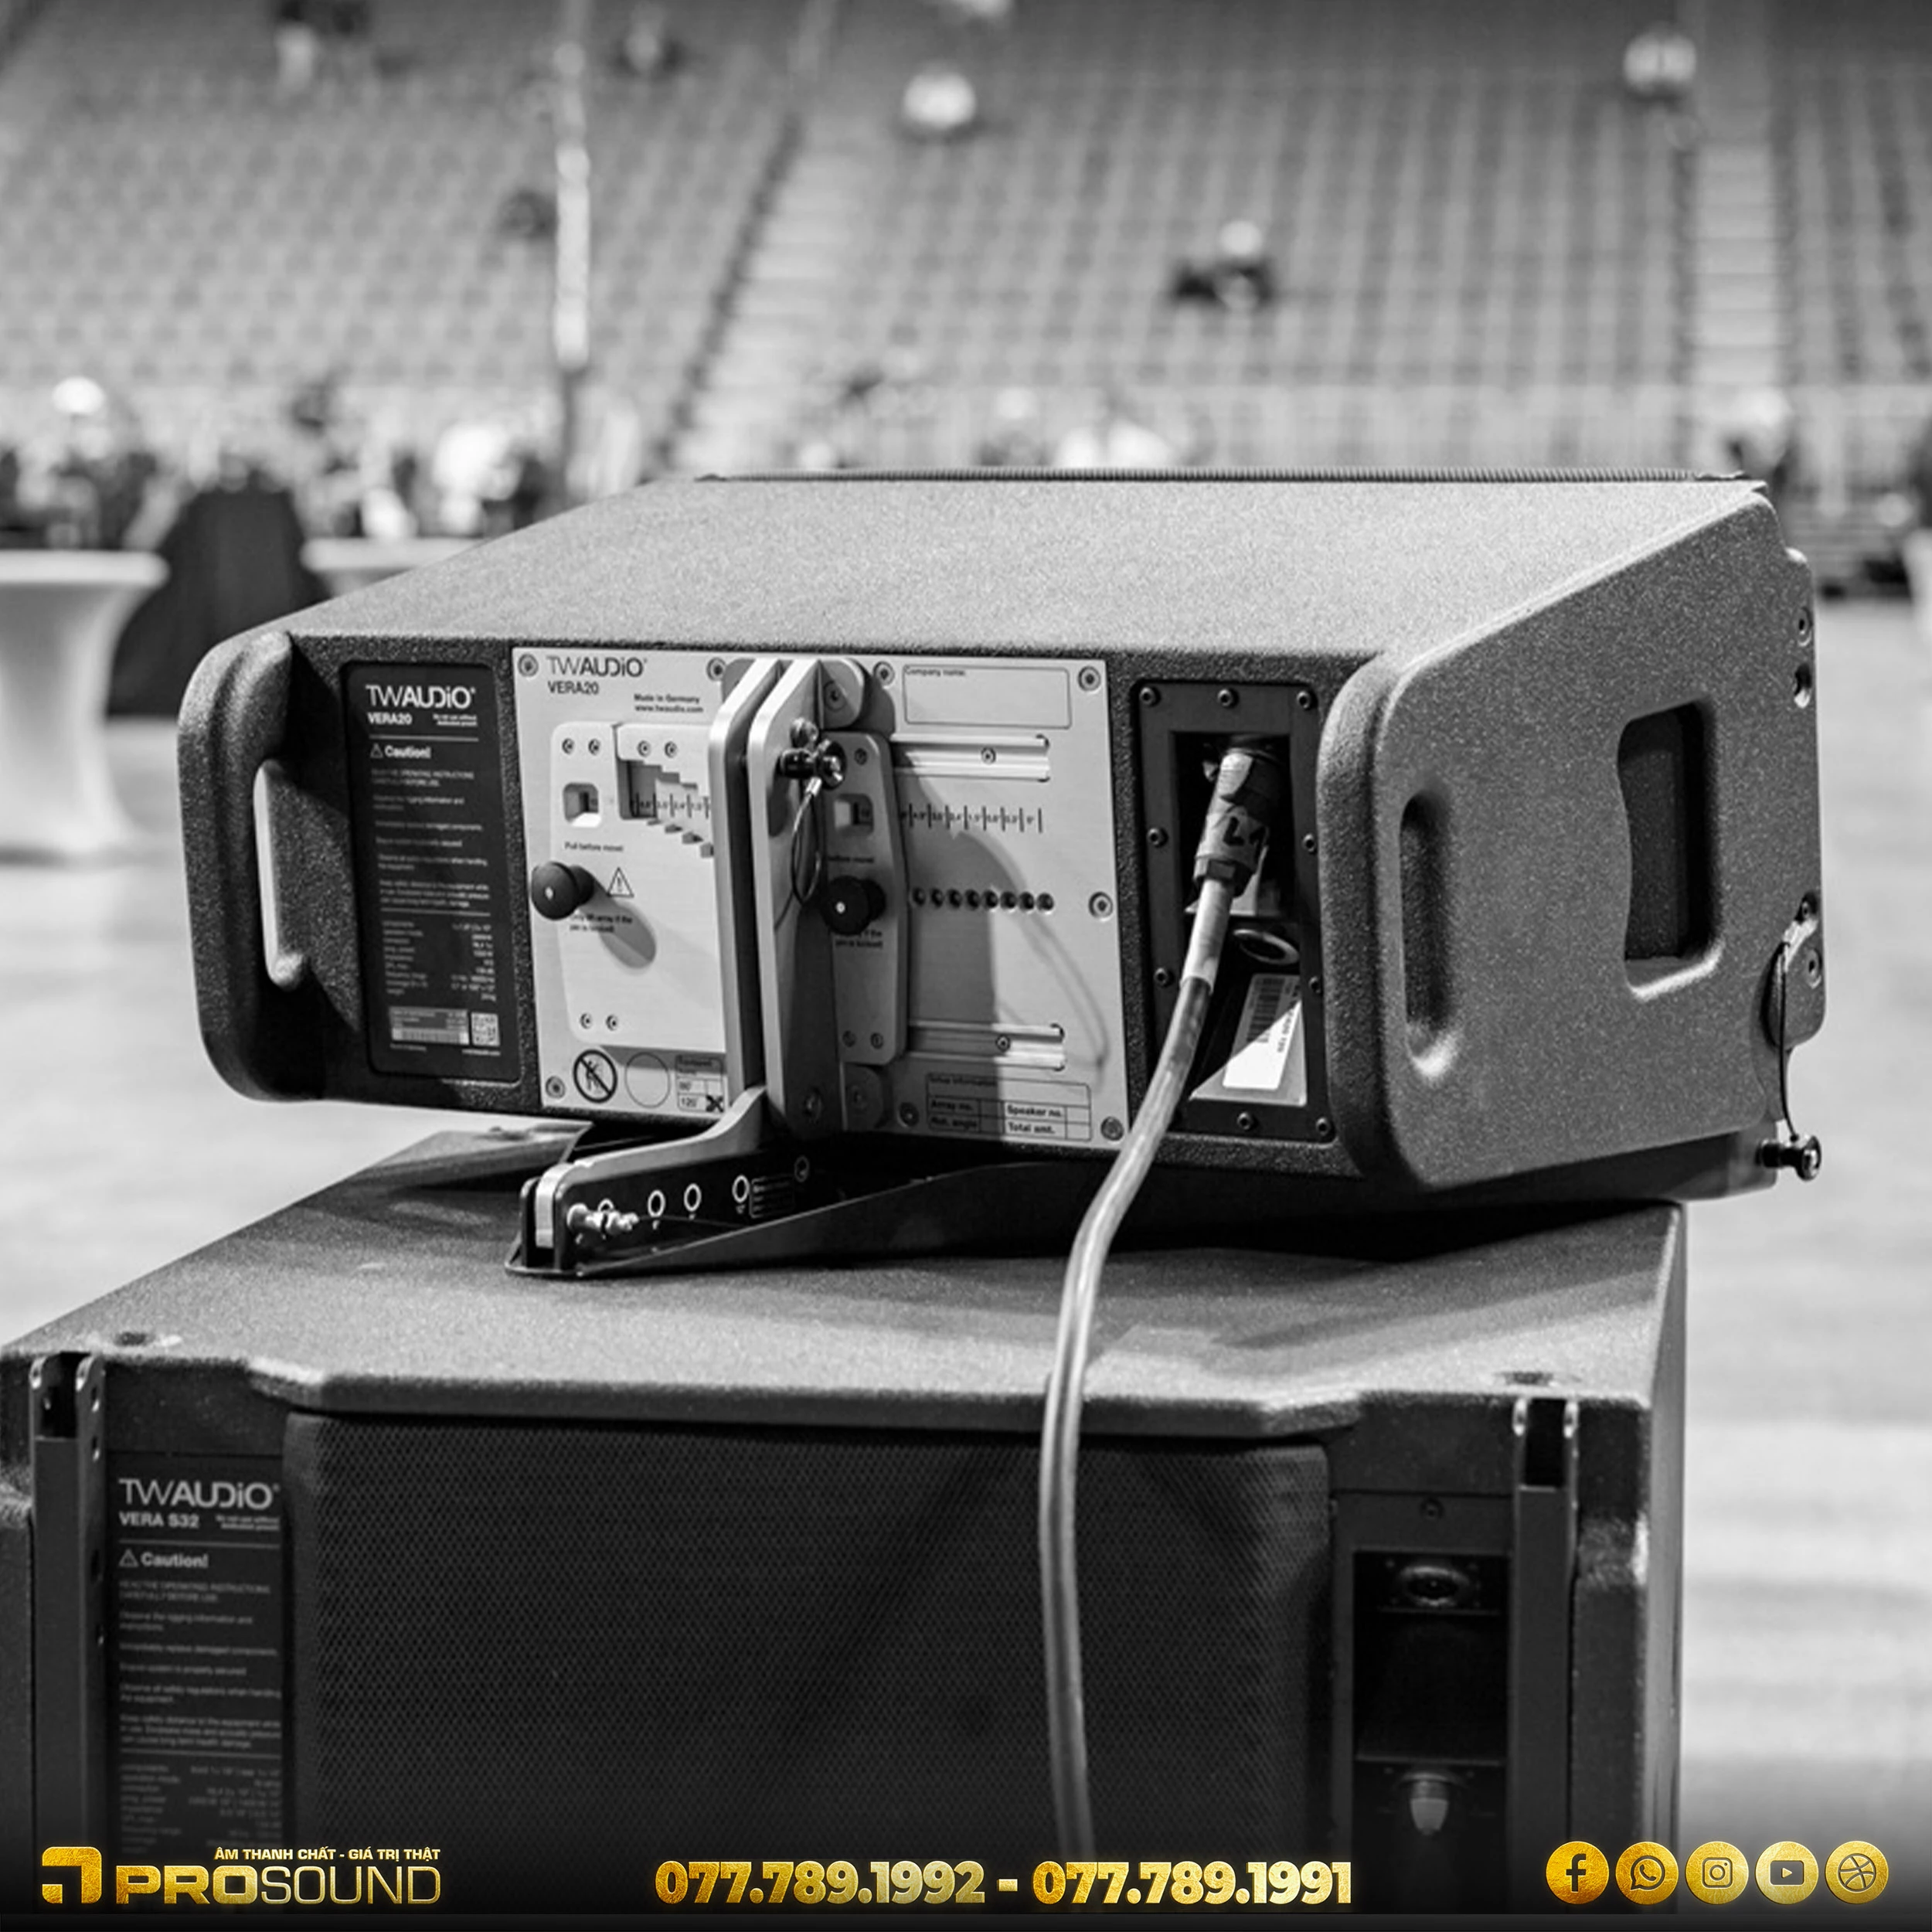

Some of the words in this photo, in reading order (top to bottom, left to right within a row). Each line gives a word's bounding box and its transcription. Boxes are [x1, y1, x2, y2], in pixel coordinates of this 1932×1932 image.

[548, 681, 600, 695] VERA20
[665, 693, 700, 704] Germany
[367, 712, 413, 725] VERA20
[385, 745, 432, 759] Caution!
[1007, 1104, 1046, 1117] Speaker
[1008, 1121, 1032, 1133] Total
[119, 1511, 165, 1527] VERA
[168, 1512, 200, 1529] S32
[140, 1552, 209, 1569] Caution!
